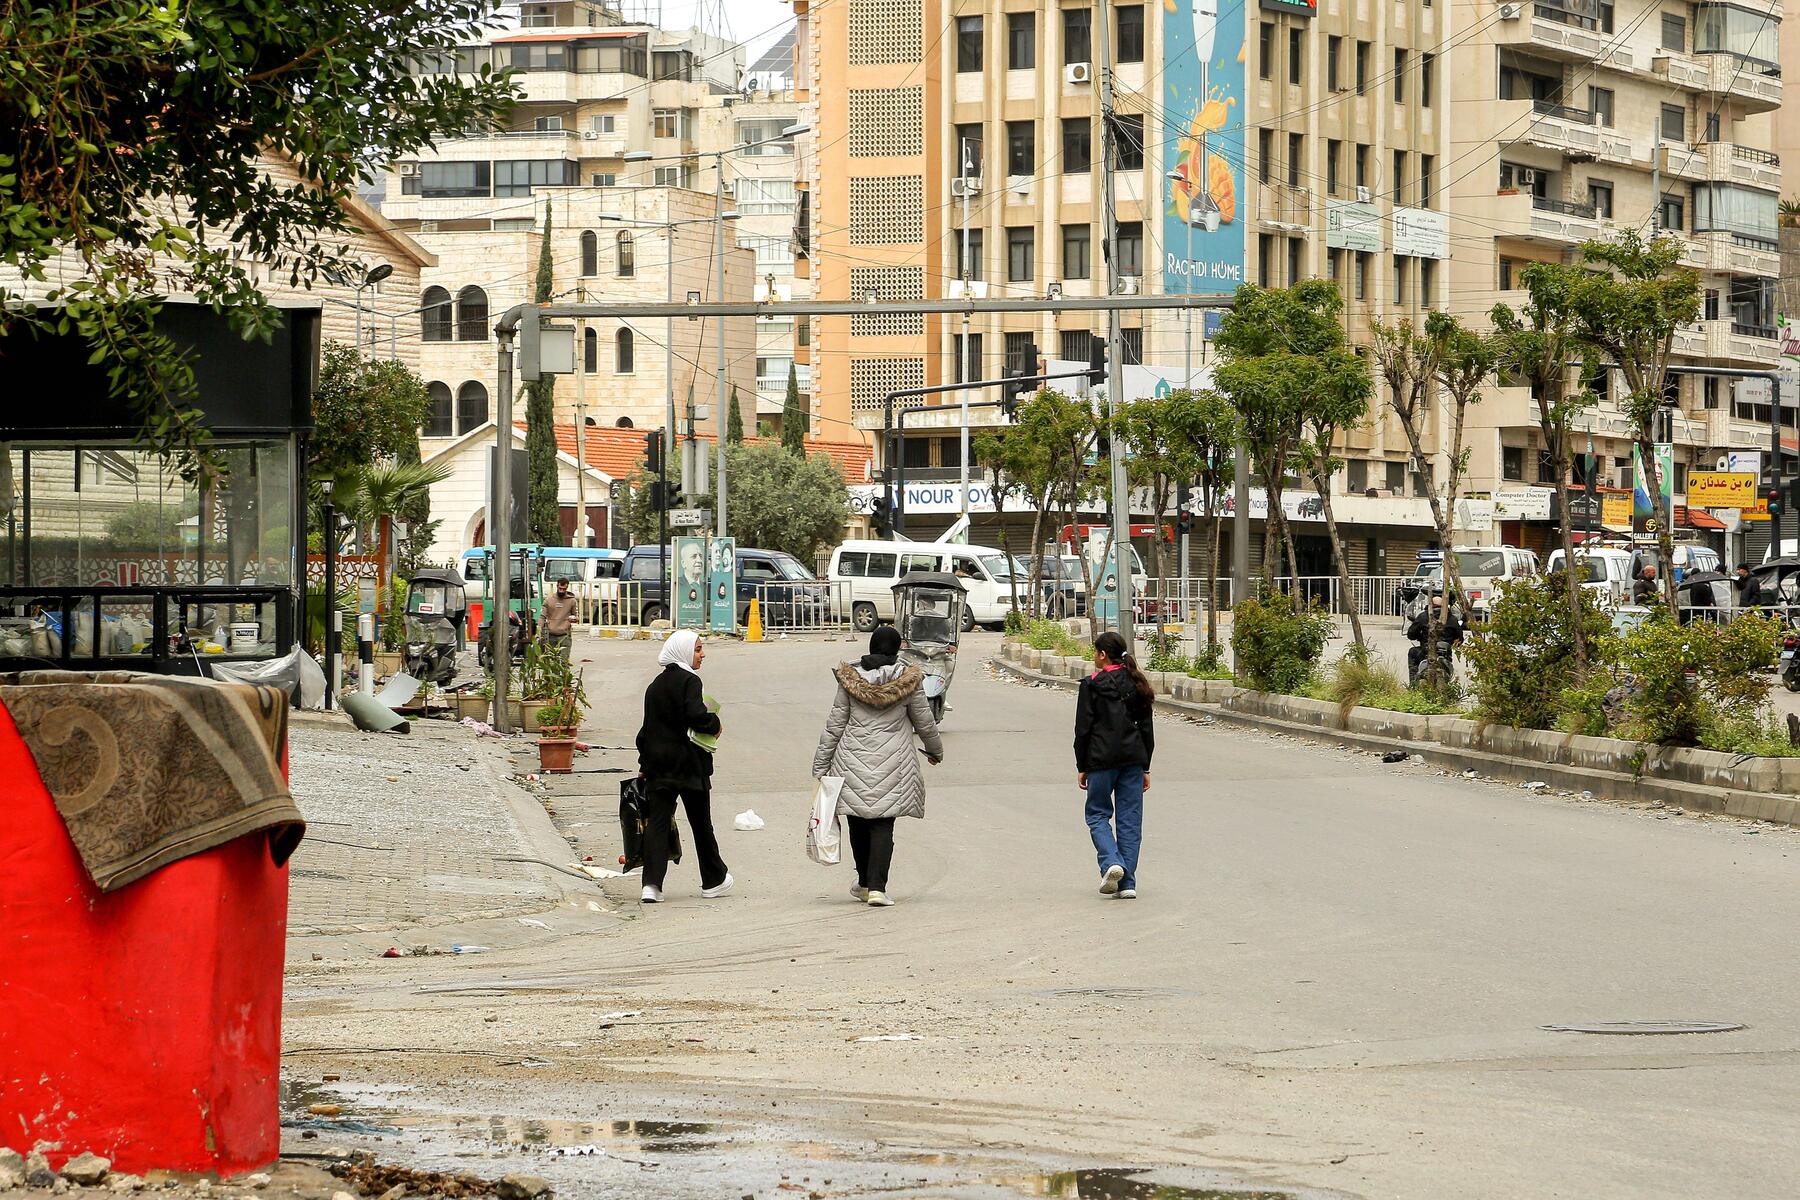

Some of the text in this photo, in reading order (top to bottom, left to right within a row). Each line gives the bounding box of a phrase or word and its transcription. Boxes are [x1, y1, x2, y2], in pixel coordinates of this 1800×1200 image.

[1211, 260, 1241, 281] HOME
[1700, 475, 1742, 491] بن عدنان
[908, 489, 954, 504] NOUR
[1633, 532, 1655, 540] GALLERY
